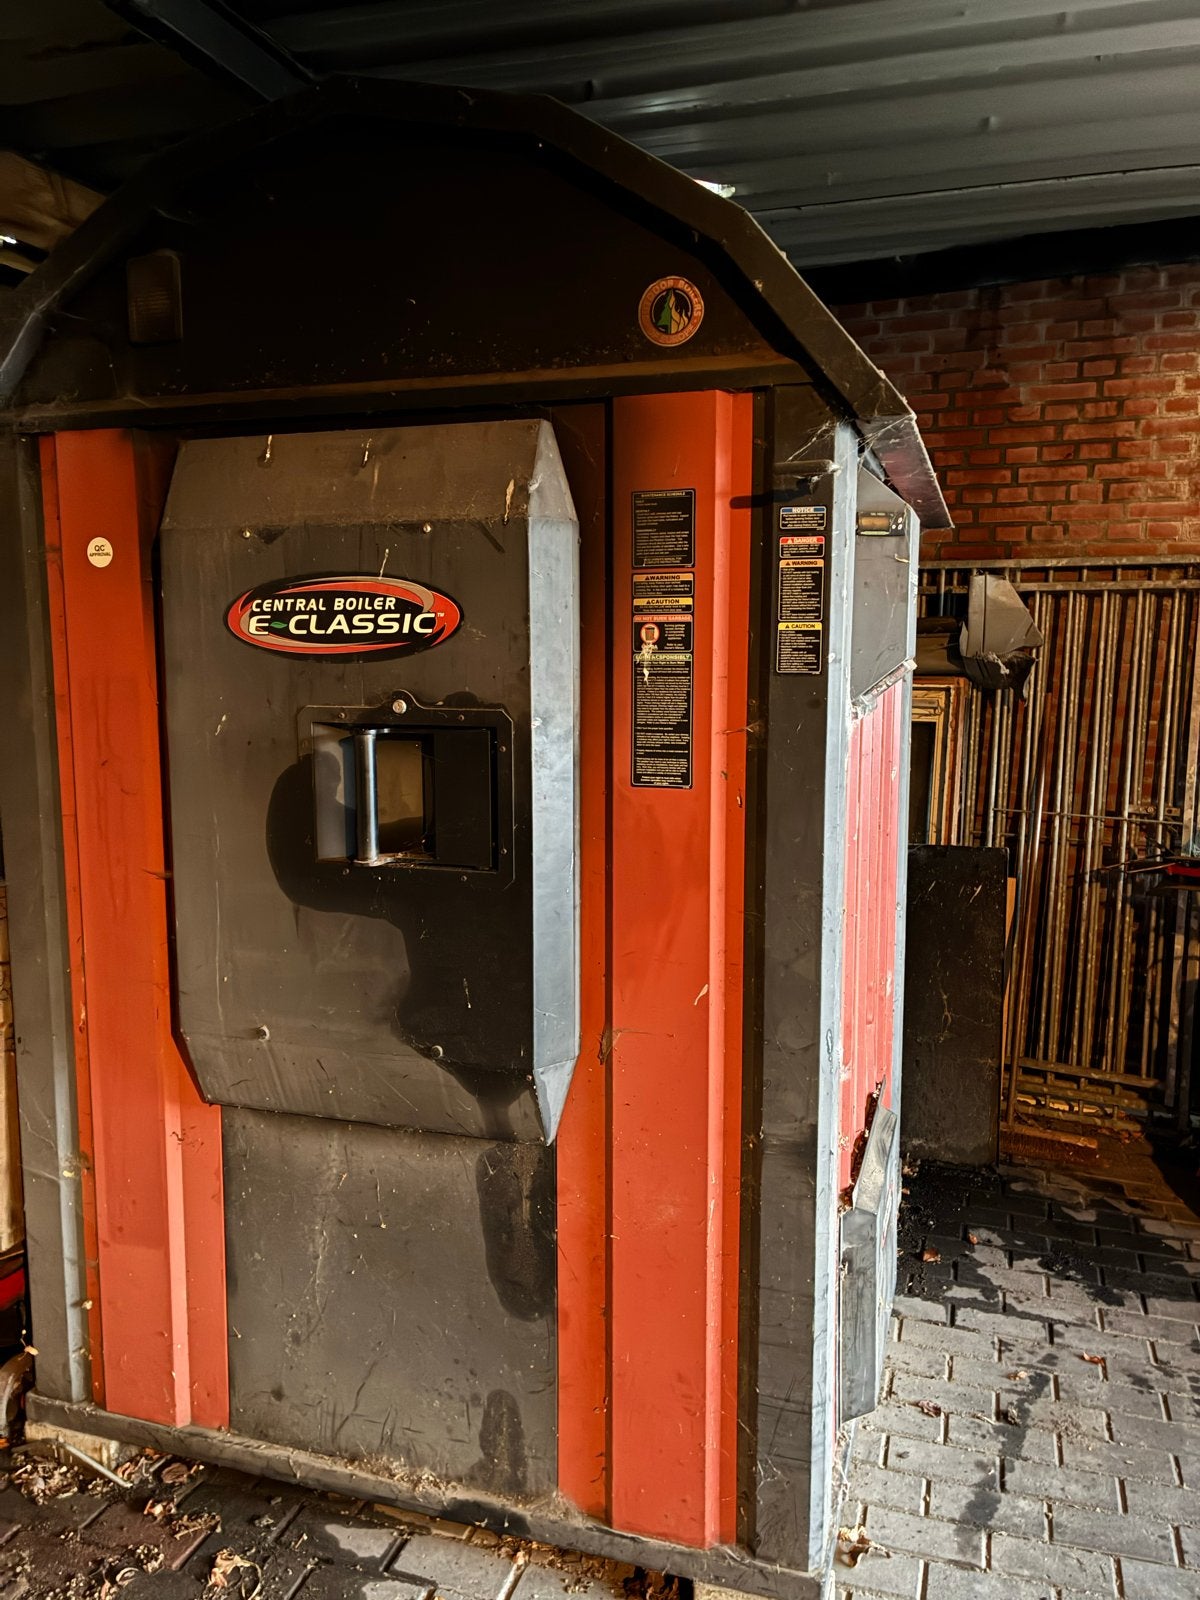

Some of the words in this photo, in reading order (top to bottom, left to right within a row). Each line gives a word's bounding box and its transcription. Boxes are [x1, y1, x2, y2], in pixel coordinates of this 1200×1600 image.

[94, 544, 105, 552] QC
[252, 598, 327, 612] CENTRAL
[333, 597, 396, 611] BOILER
